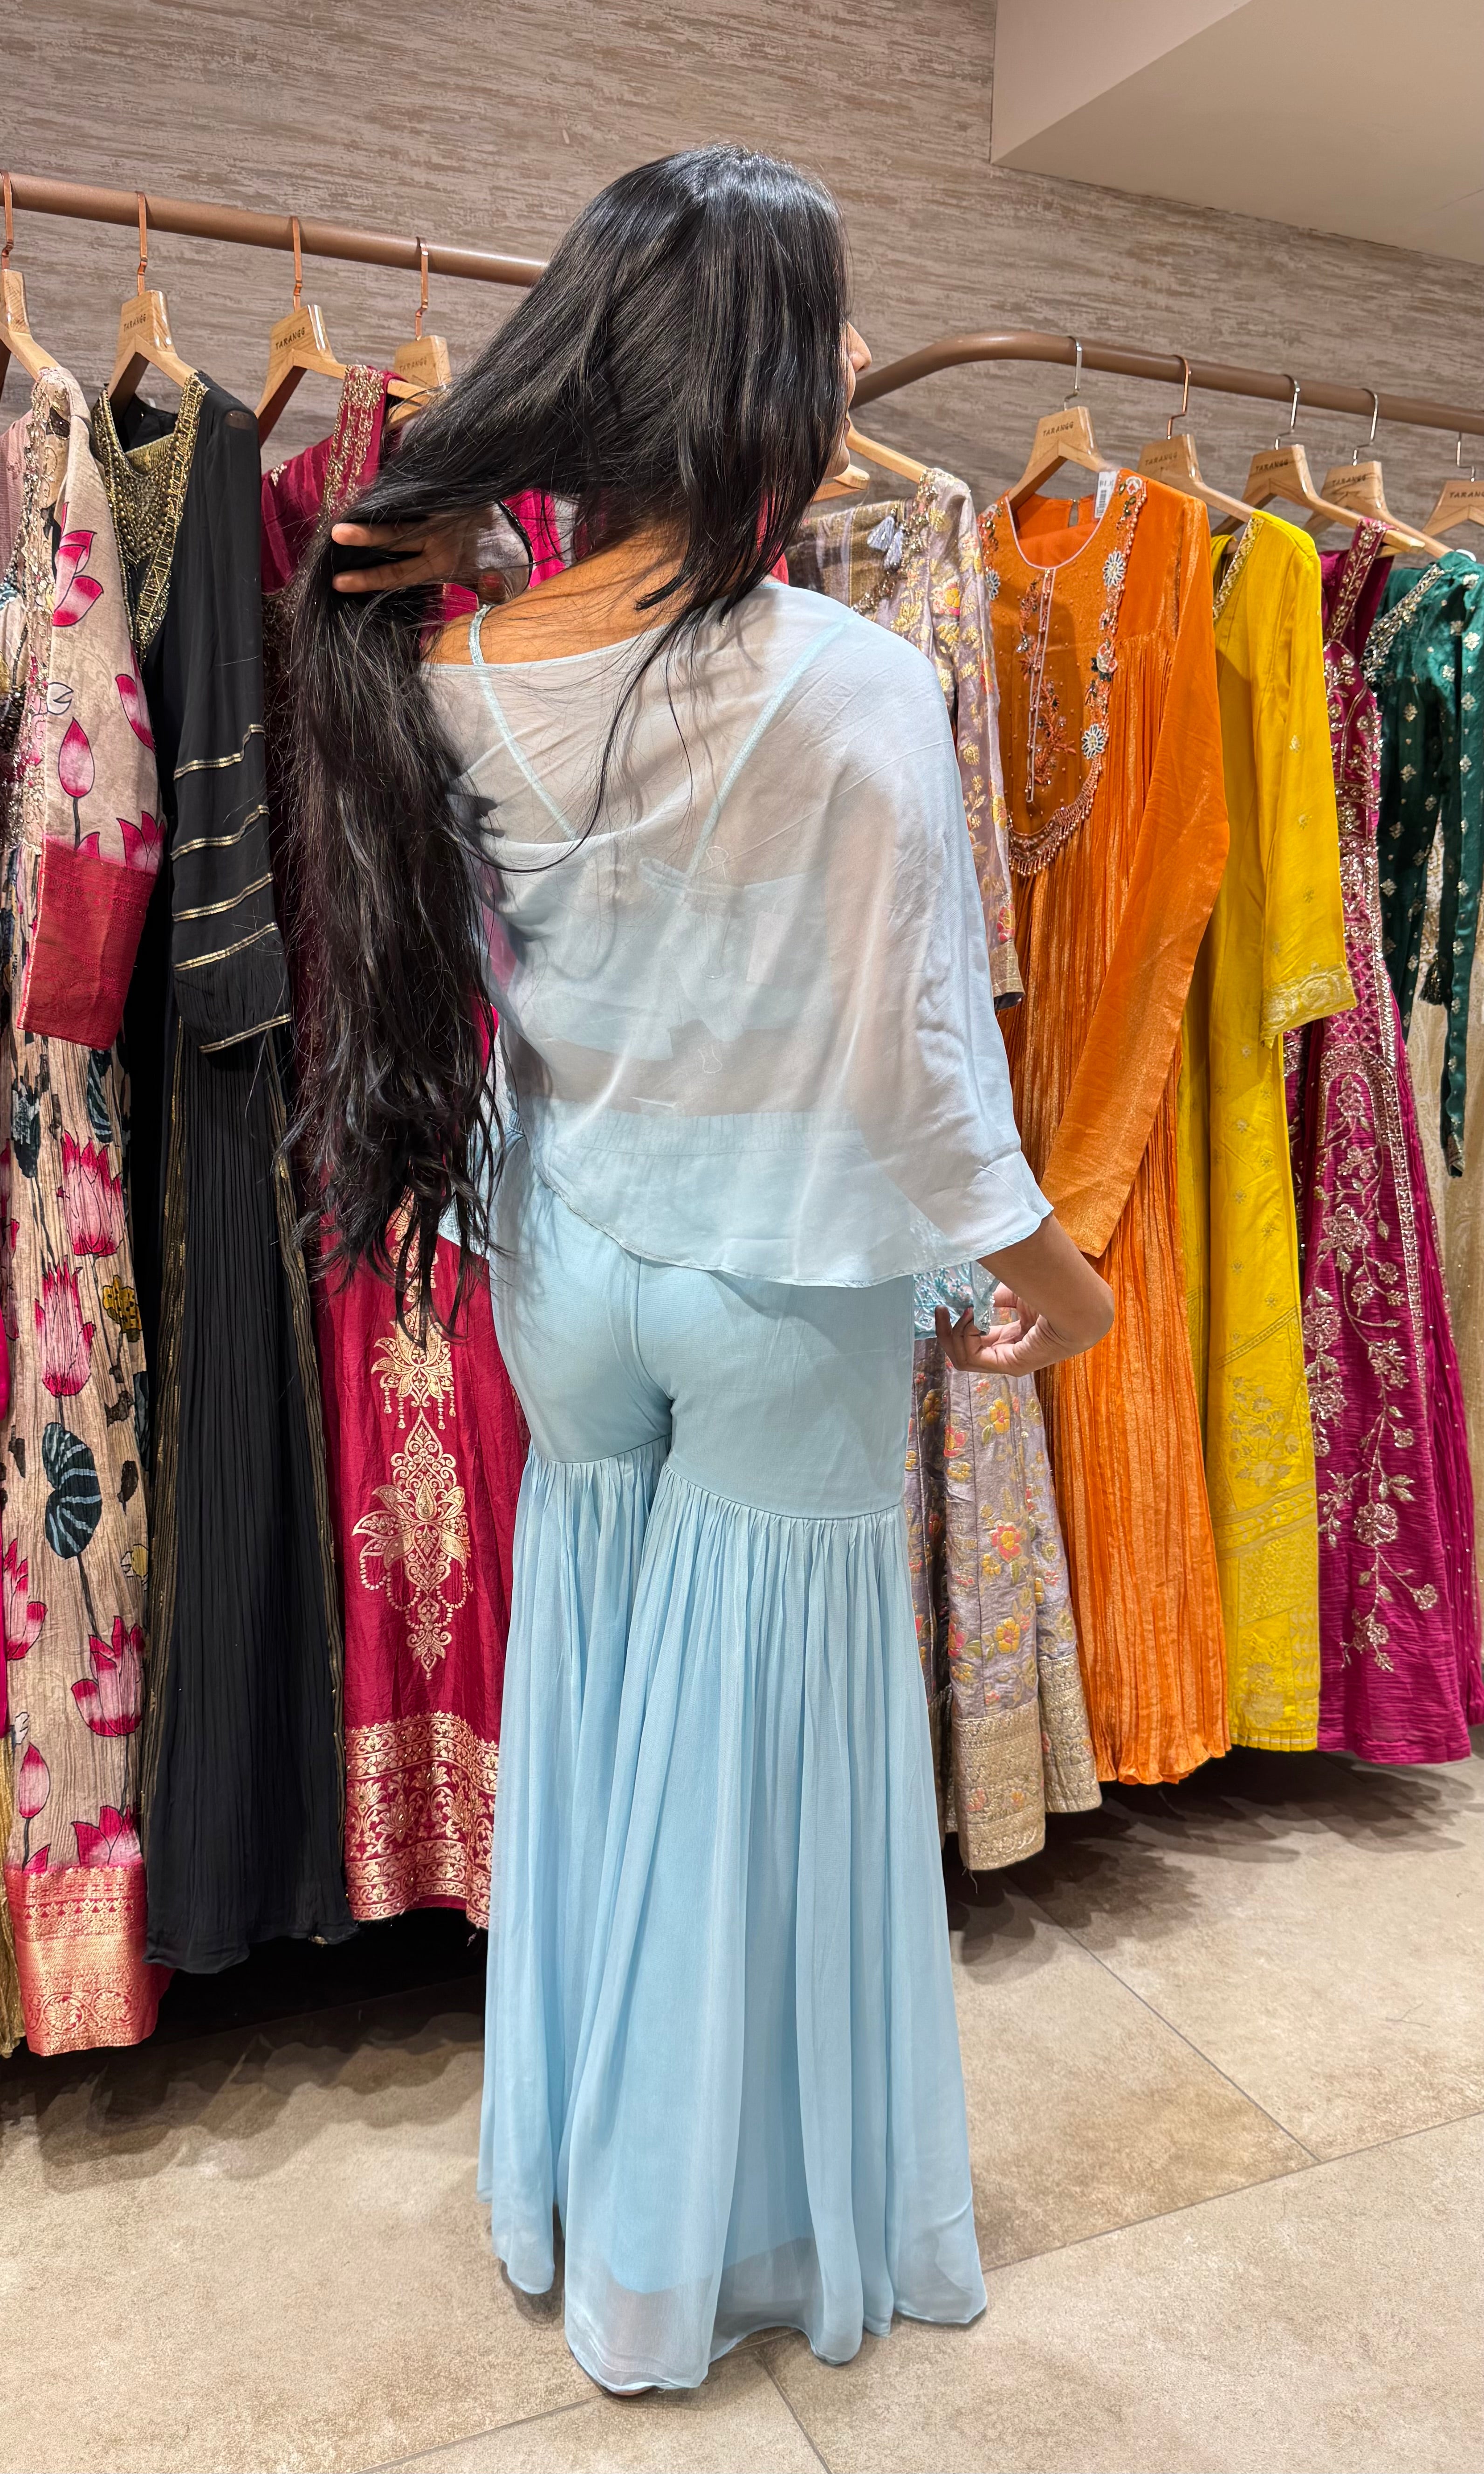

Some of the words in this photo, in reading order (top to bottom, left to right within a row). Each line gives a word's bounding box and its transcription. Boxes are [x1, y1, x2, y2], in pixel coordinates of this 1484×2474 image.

[124, 313, 146, 332] TARANGG
[275, 327, 305, 350] TARANGG
[1043, 421, 1074, 437] TARANGG
[1145, 451, 1177, 467] TARANGG
[1256, 459, 1289, 472] TARANGG
